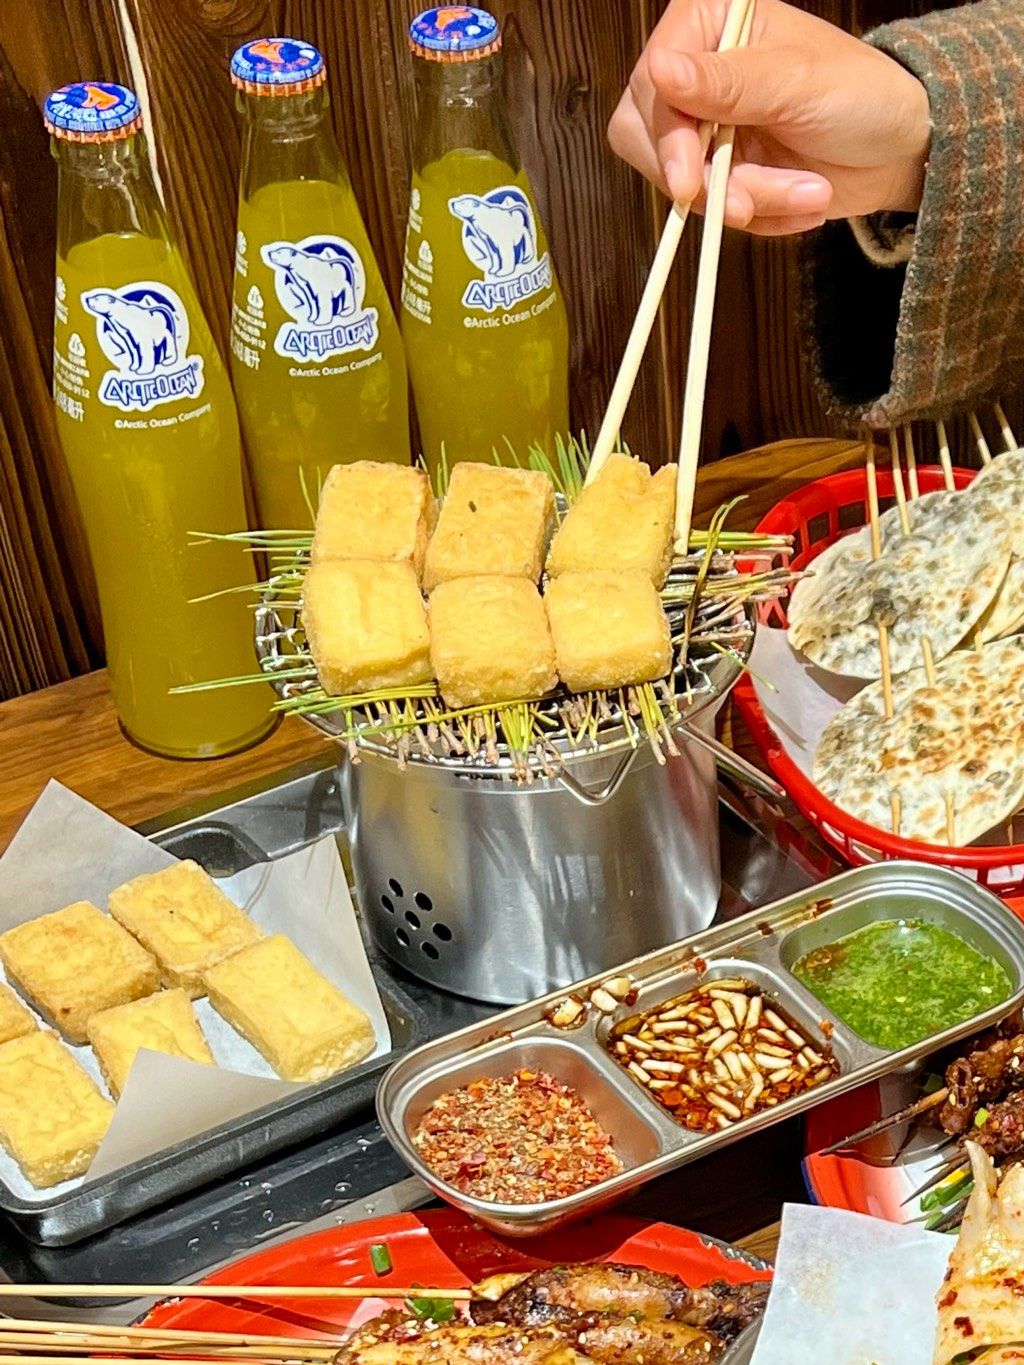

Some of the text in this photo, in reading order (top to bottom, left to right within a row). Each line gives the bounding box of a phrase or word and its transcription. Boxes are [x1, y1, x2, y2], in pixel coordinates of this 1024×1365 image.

[502, 310, 531, 325] Ocean
[322, 363, 349, 376] Ocean
[350, 352, 383, 370] Company
[149, 415, 177, 428] Ocean
[178, 403, 212, 422] Company
